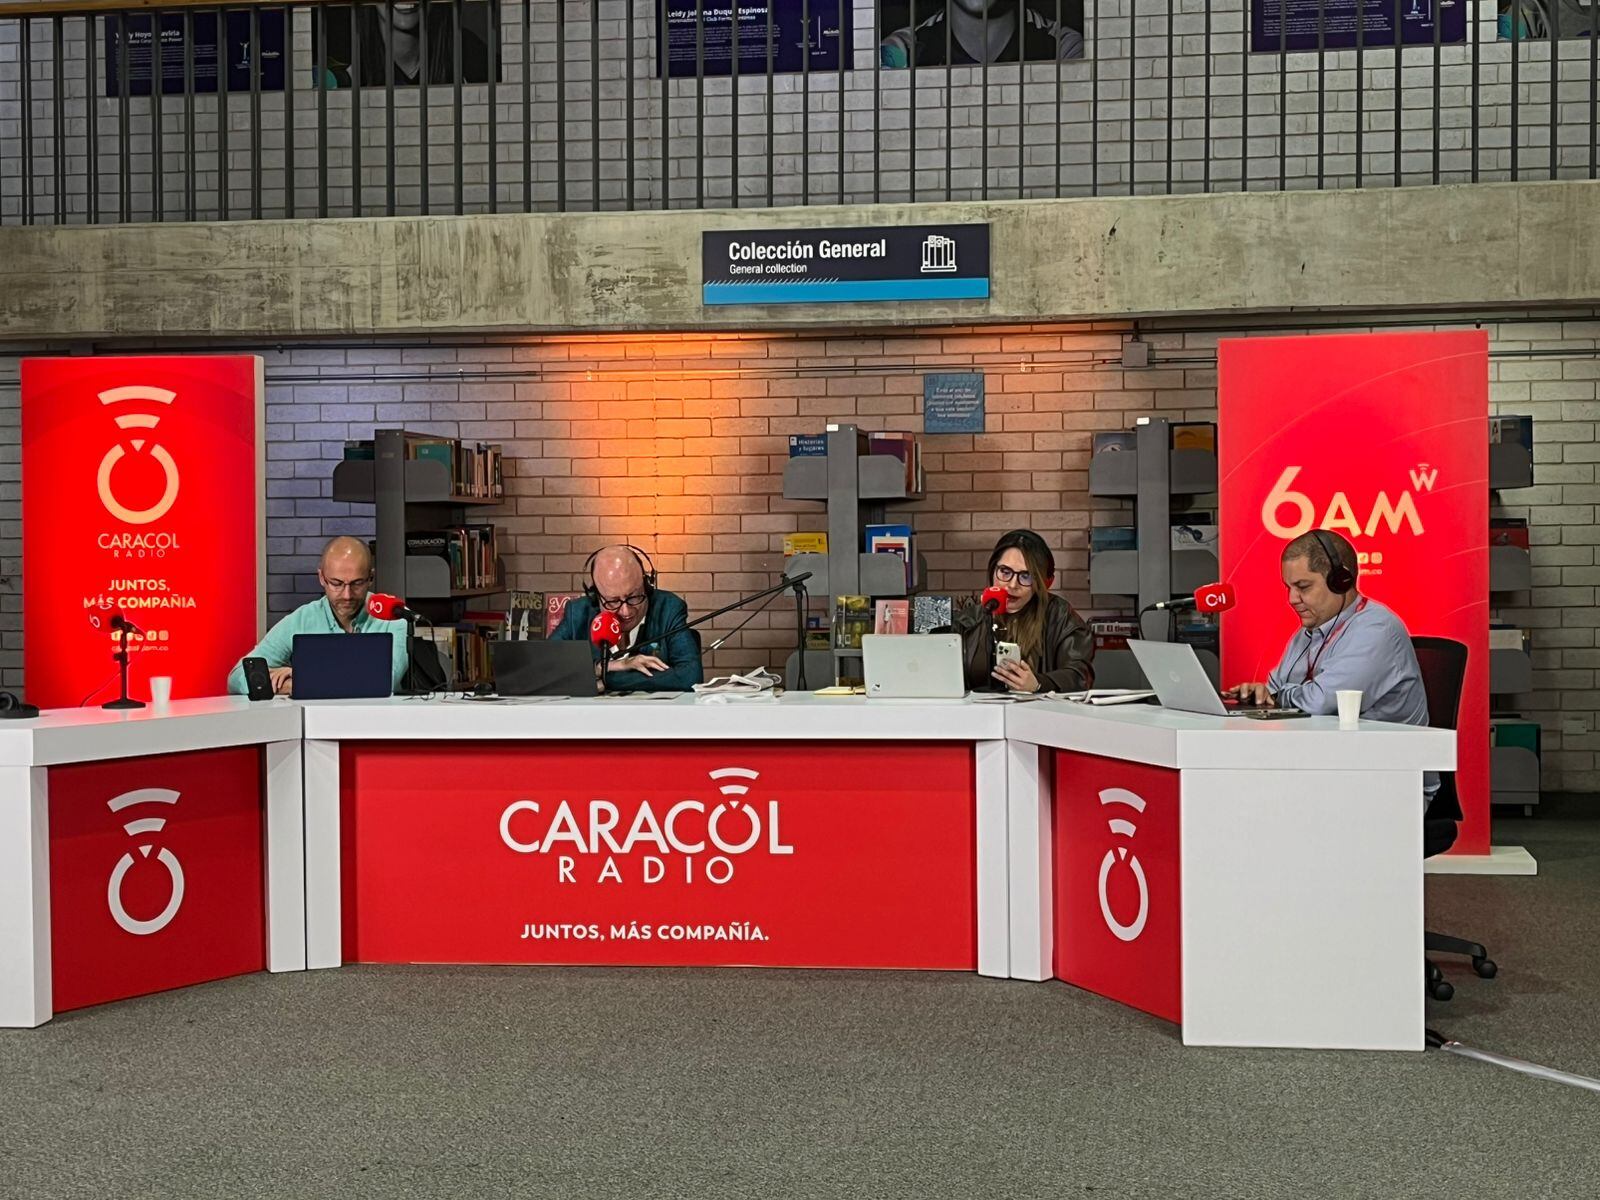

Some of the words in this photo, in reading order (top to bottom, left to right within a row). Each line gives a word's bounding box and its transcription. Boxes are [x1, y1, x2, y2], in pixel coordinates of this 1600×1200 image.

[729, 240, 813, 260] Colección
[819, 239, 886, 259] General
[730, 264, 763, 274] General
[765, 263, 807, 274] collection
[1262, 466, 1425, 539] 6AM
[97, 532, 180, 549] CARACOL
[113, 549, 166, 558] RADIO
[108, 579, 171, 592] JUNTOS,
[512, 598, 542, 609] KING
[500, 799, 794, 854] CARACOL
[559, 856, 734, 884] RADIO
[520, 924, 605, 941] JUNTOS,
[610, 921, 651, 940] MÁS
[657, 921, 769, 941] COMPAÑÍA.
